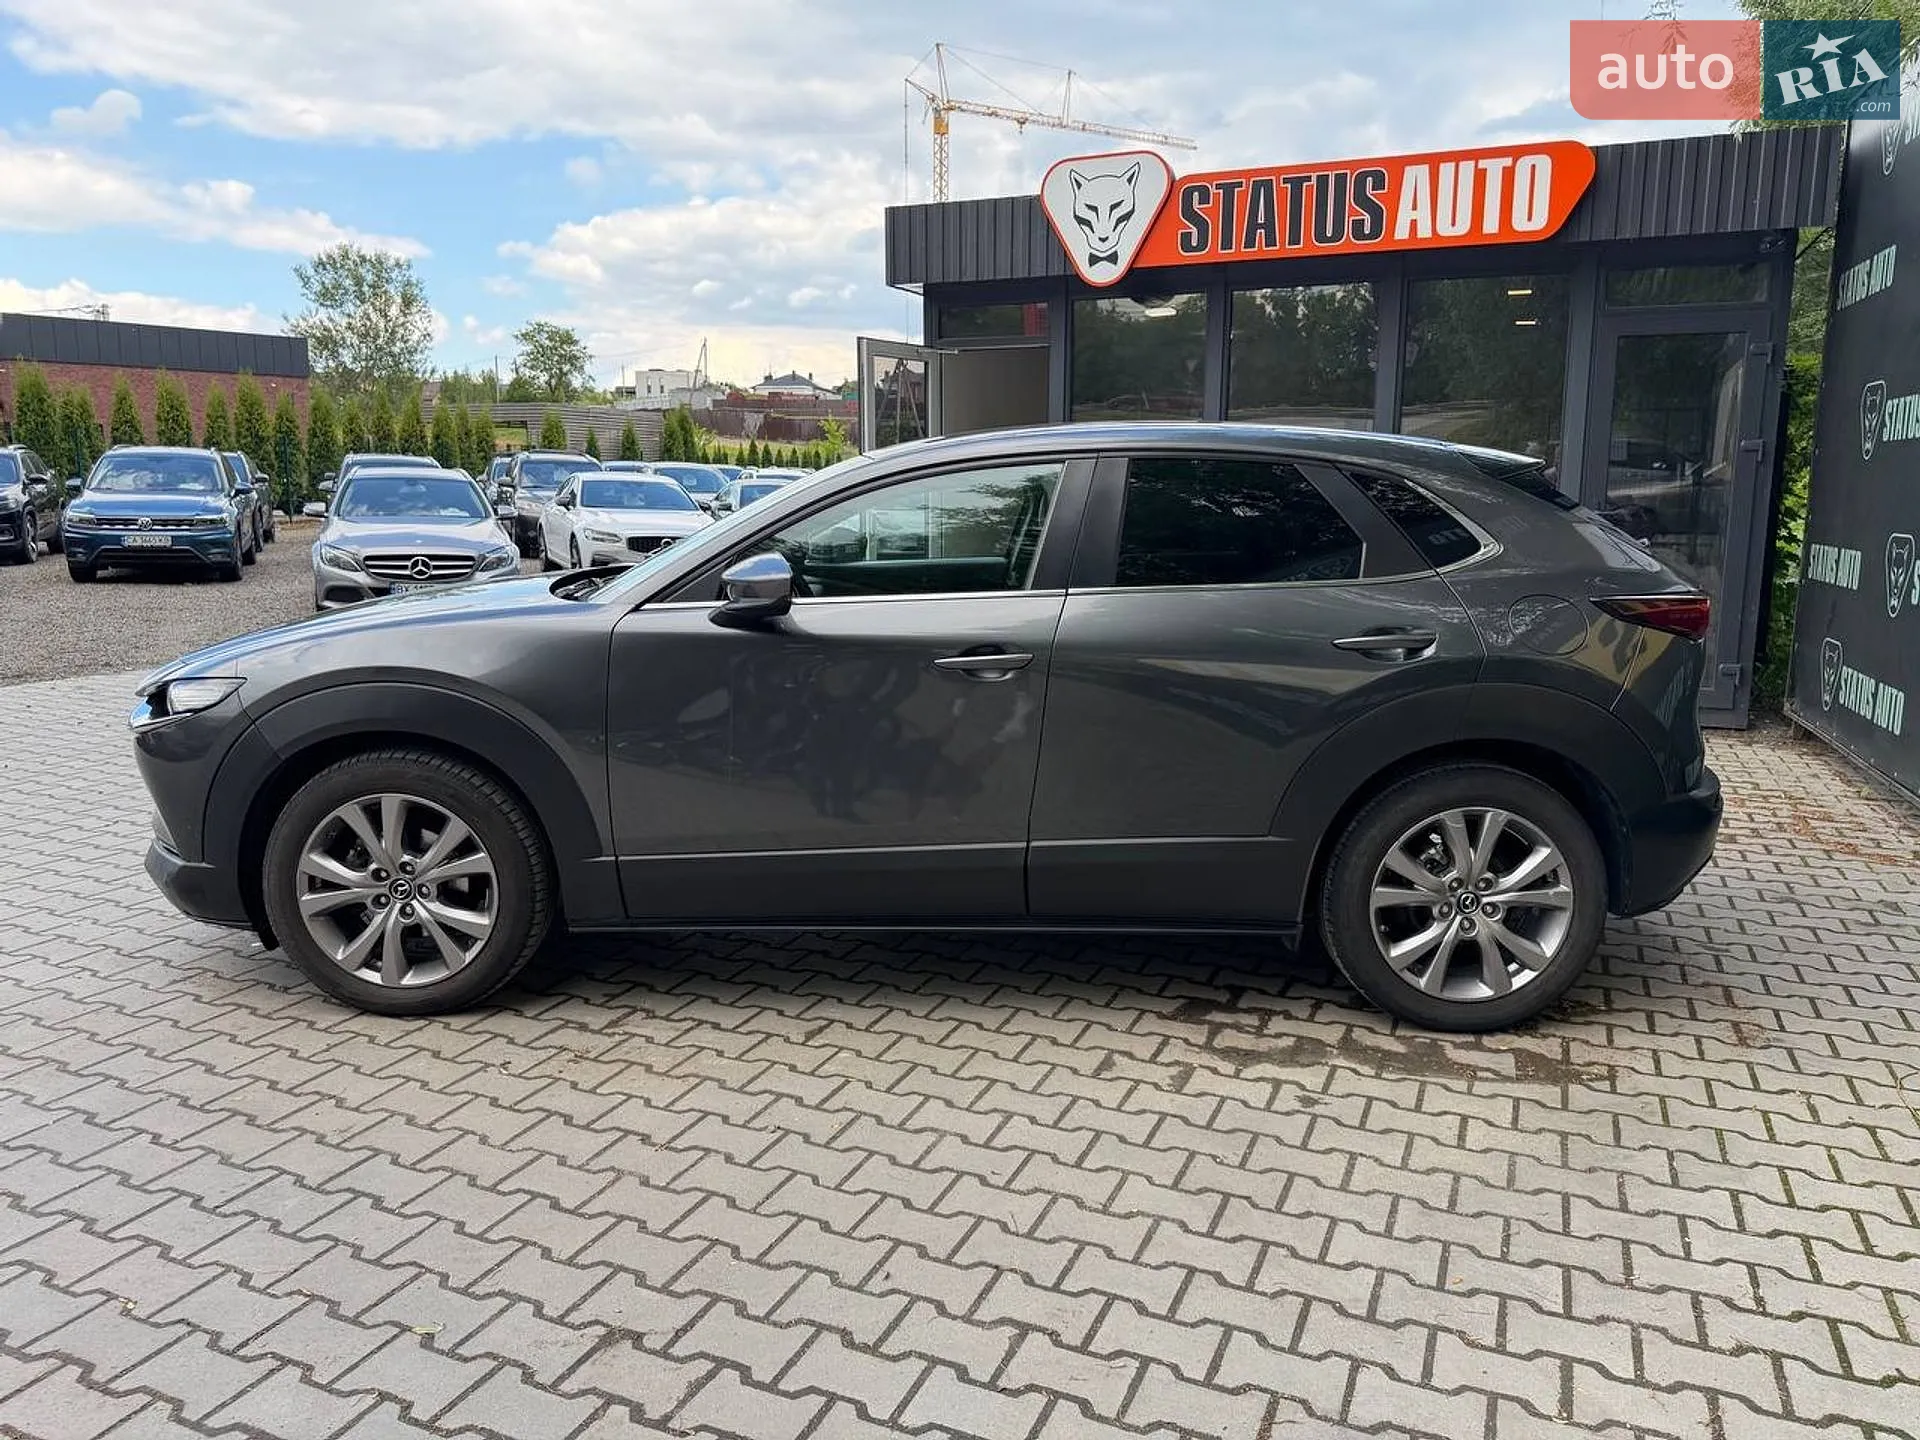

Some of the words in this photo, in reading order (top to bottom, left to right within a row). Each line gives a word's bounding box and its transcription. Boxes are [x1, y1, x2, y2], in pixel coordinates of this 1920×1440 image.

[1177, 167, 1387, 256] STATUS
[1392, 153, 1553, 240] AUTO
[1837, 259, 1870, 311] STATUS
[1868, 244, 1897, 296] AUTO
[1808, 543, 1839, 584] STATUS
[1836, 547, 1861, 590] AUTO
[1839, 665, 1875, 720] STATUS
[1873, 681, 1905, 736] AUTO
